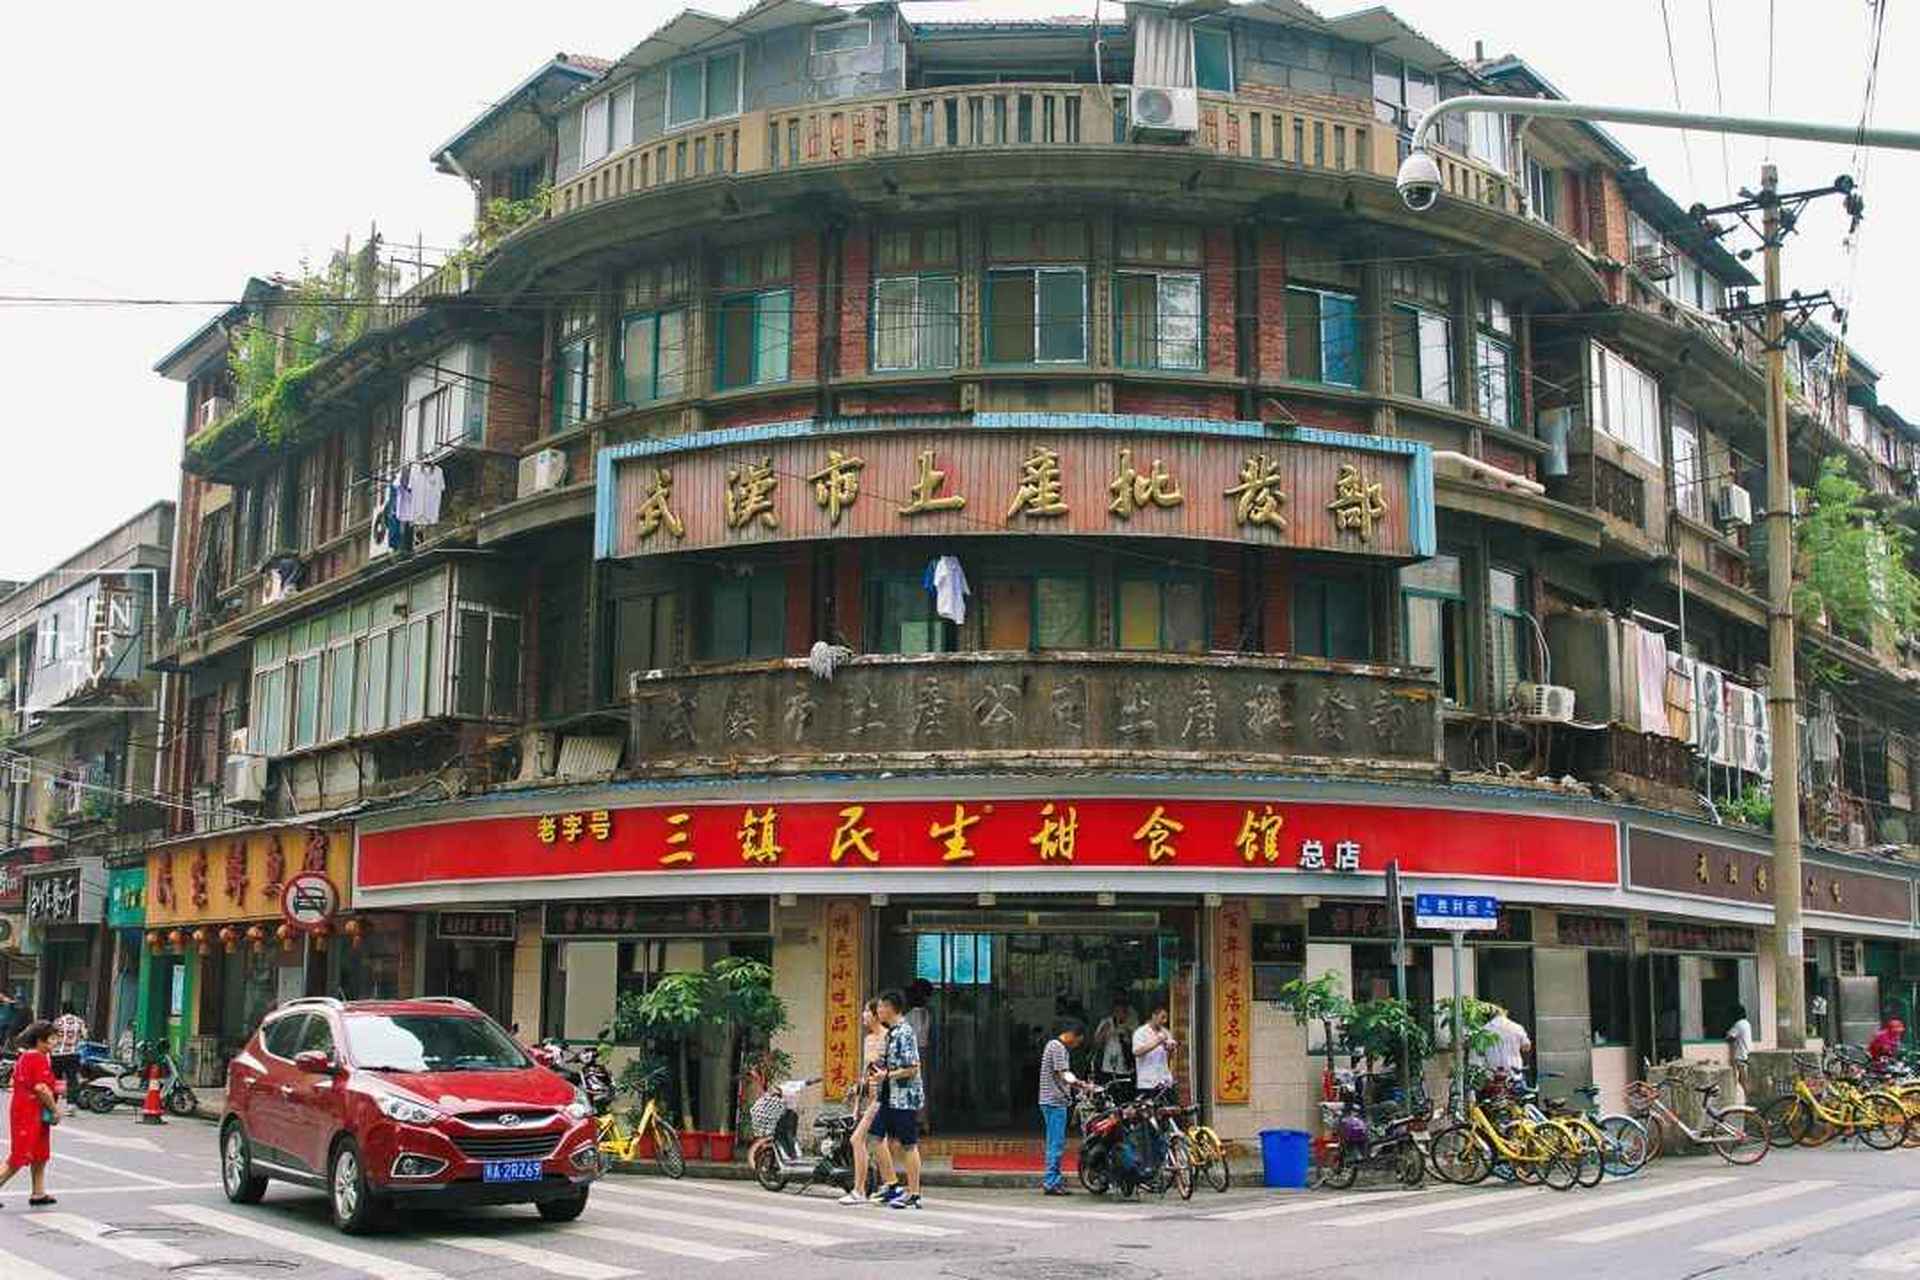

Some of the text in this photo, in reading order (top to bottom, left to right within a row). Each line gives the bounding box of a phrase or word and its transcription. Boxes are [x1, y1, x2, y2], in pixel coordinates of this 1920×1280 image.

[537, 804, 1361, 870] 老字号 三镇民生甜食馆 总店
